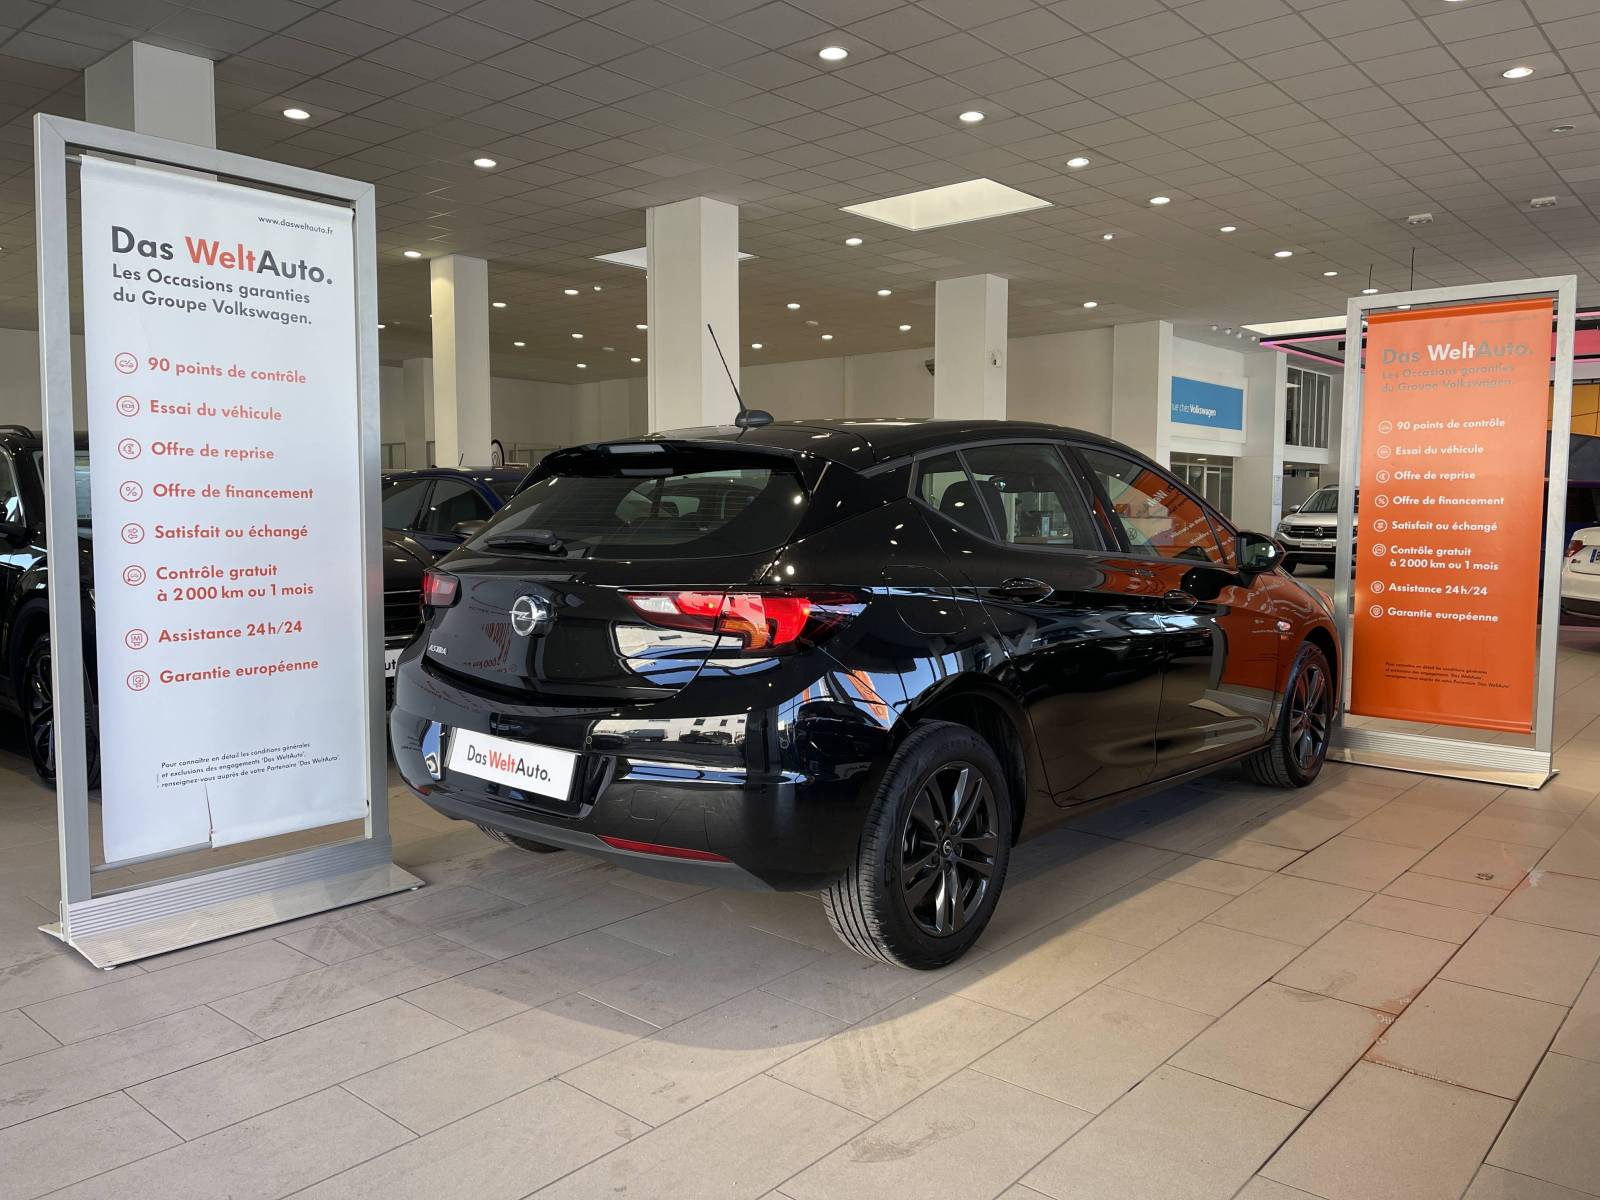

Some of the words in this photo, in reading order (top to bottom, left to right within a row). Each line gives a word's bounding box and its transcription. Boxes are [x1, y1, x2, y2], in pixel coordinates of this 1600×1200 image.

[258, 215, 333, 235] www.dasweltauto.fr
[111, 225, 174, 260] Das
[184, 236, 333, 285] WeltAuto.
[112, 263, 141, 281] Les
[147, 268, 233, 293] Occasions
[238, 283, 311, 304] garanties
[113, 287, 136, 302] du
[142, 290, 207, 312] Groupe
[212, 299, 312, 325] Volkswagen.
[1382, 347, 1421, 365] Das
[1427, 339, 1534, 361] WeltAuto.
[148, 357, 170, 372] 90
[175, 362, 223, 377] points
[227, 365, 246, 378] de
[250, 368, 306, 384] contrôle
[1402, 366, 1456, 378] Occasions
[150, 399, 191, 415] Essai
[197, 402, 216, 416] du
[222, 404, 282, 421] véhicule
[1396, 421, 1410, 431] 90
[1413, 421, 1444, 432] points
[1447, 419, 1460, 429] de
[1463, 417, 1505, 429] contrôle
[151, 441, 194, 457] Offre
[200, 444, 219, 457] de
[224, 446, 274, 461] reprise
[1395, 445, 1421, 456] Essai
[1424, 445, 1437, 455] du
[1440, 444, 1484, 455] véhicule
[1394, 470, 1421, 480] Offre
[1424, 470, 1437, 480] de
[1440, 471, 1476, 482] reprise
[153, 483, 196, 498] Offre
[201, 484, 221, 498] de
[225, 485, 314, 499] financement
[1392, 496, 1420, 506] Offre
[1422, 496, 1435, 505] de
[1438, 495, 1504, 505] financement
[154, 524, 220, 539] Satisfait
[225, 527, 243, 538] ou
[248, 523, 308, 541] échangé
[1391, 520, 1433, 531] Satisfait
[1435, 522, 1449, 531] ou
[1452, 521, 1498, 533] échangé
[1390, 545, 1433, 556] Contrôle
[1436, 547, 1472, 558] gratuit
[156, 564, 224, 580] Contrôle
[229, 564, 278, 581] gratuit
[1389, 558, 1397, 568] à
[1430, 559, 1446, 569] km
[1448, 561, 1462, 570] ou
[1465, 560, 1470, 569] 1
[1472, 561, 1499, 571] mois
[157, 588, 168, 602] à
[221, 585, 244, 599] km
[248, 587, 266, 598] ou
[270, 584, 276, 596] 1
[281, 582, 314, 596] mois
[1388, 583, 1442, 594] Assistance
[1387, 607, 1433, 618] Garantie
[1435, 611, 1498, 622] européenne
[158, 626, 242, 643] Assistance
[159, 666, 230, 684] Garantie
[235, 659, 319, 678] européenne
[161, 761, 177, 769] Pour
[240, 751, 250, 759] les
[250, 747, 281, 757] conditions
[467, 744, 487, 766] Das
[489, 749, 551, 782] WeltAuto.
[170, 767, 204, 778] exclusions
[205, 765, 218, 773] des
[218, 759, 260, 771] engagements
[250, 767, 265, 775] votre
